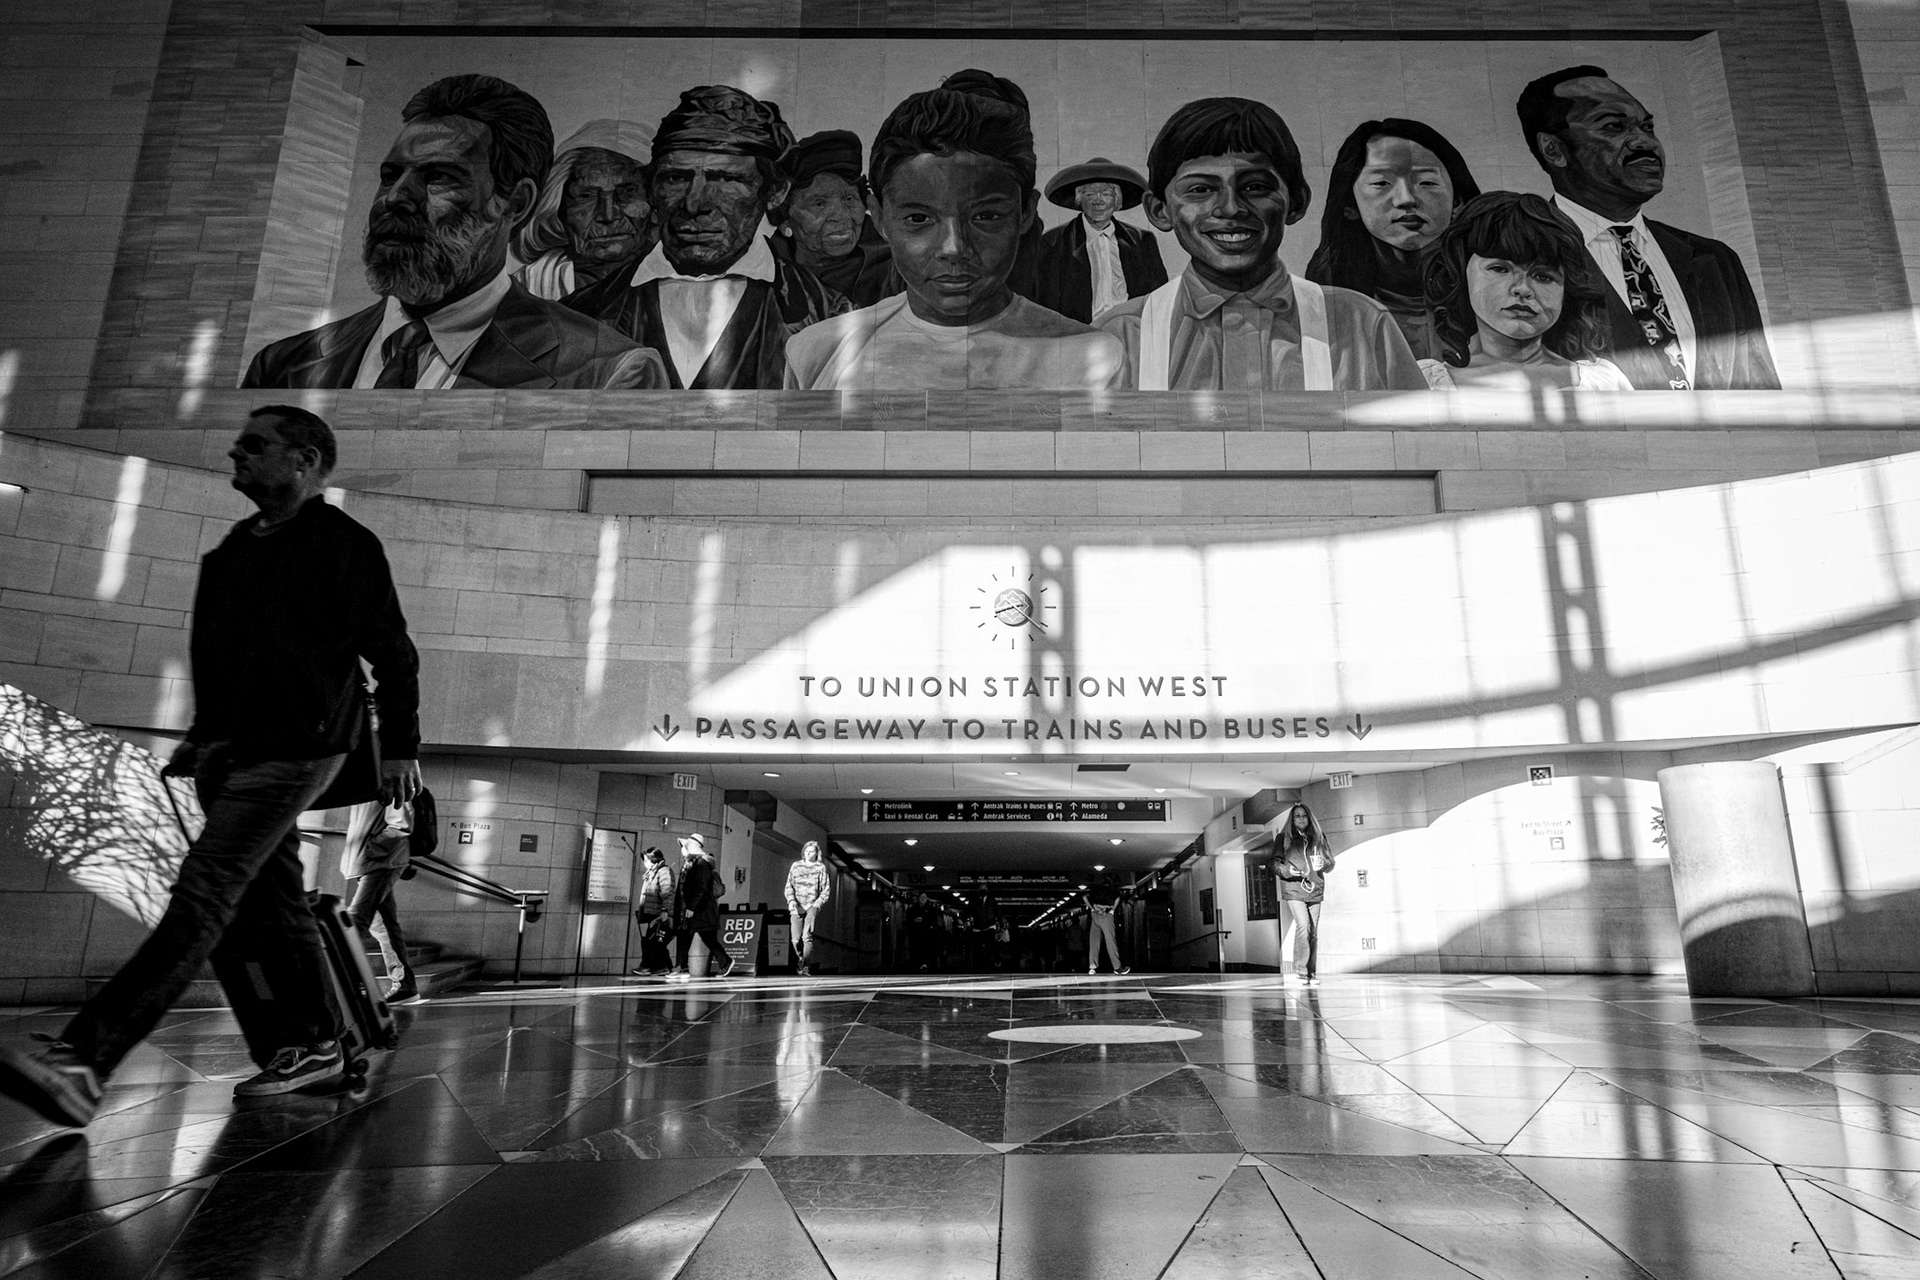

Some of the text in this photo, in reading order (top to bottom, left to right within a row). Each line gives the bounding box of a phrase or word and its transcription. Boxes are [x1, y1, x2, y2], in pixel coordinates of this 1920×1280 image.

[799, 676, 1227, 698] TO UNION STATION WEST
[695, 717, 1330, 740] PASSAGEWAY TO TRAINS AND BUSES
[677, 775, 695, 788] EXIT
[1332, 772, 1350, 787] EXIT
[884, 812, 896, 820] Taxi
[904, 812, 923, 820] Rental
[925, 812, 938, 820] Cars
[983, 812, 1031, 820] Amtrak Services
[1081, 812, 1108, 820] Alameda
[1547, 828, 1564, 836] Plaza
[725, 919, 755, 930] RED
[723, 932, 754, 944] CAP
[1362, 937, 1376, 950] EXIT
